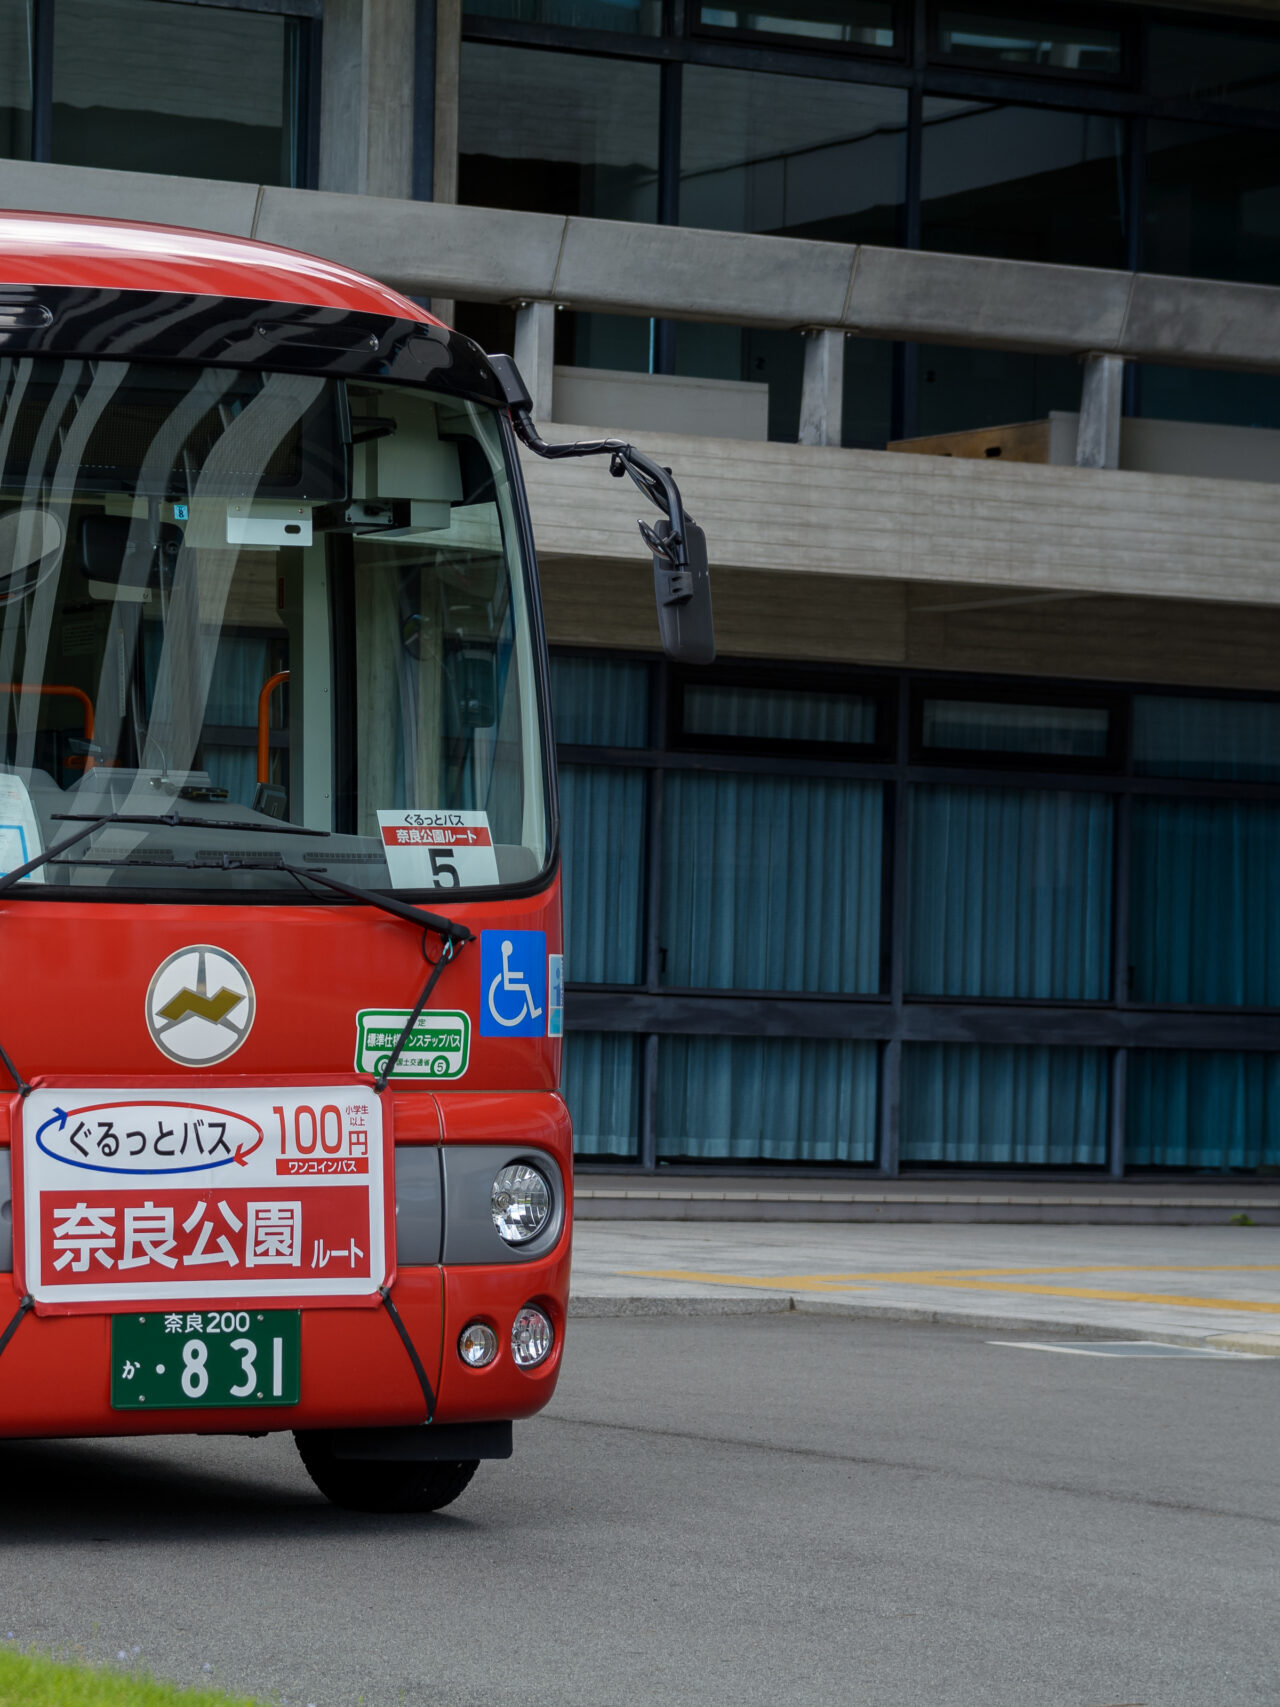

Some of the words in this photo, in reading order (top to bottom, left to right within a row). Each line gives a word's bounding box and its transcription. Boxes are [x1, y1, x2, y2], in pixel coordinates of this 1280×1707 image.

[404, 814, 464, 826] ぐるっとバス
[395, 829, 477, 844] 奈良公園ルート
[428, 848, 461, 888] 5
[367, 1033, 460, 1047] 標準仕様ンステップバス
[436, 1062, 444, 1073] 5
[345, 1104, 369, 1116] 小学生
[350, 1117, 366, 1127] 以上
[69, 1118, 232, 1157] ぐるっとバス
[288, 1160, 358, 1174] ワンコインバス
[164, 1312, 250, 1334] 奈良200
[121, 1360, 141, 1380] か
